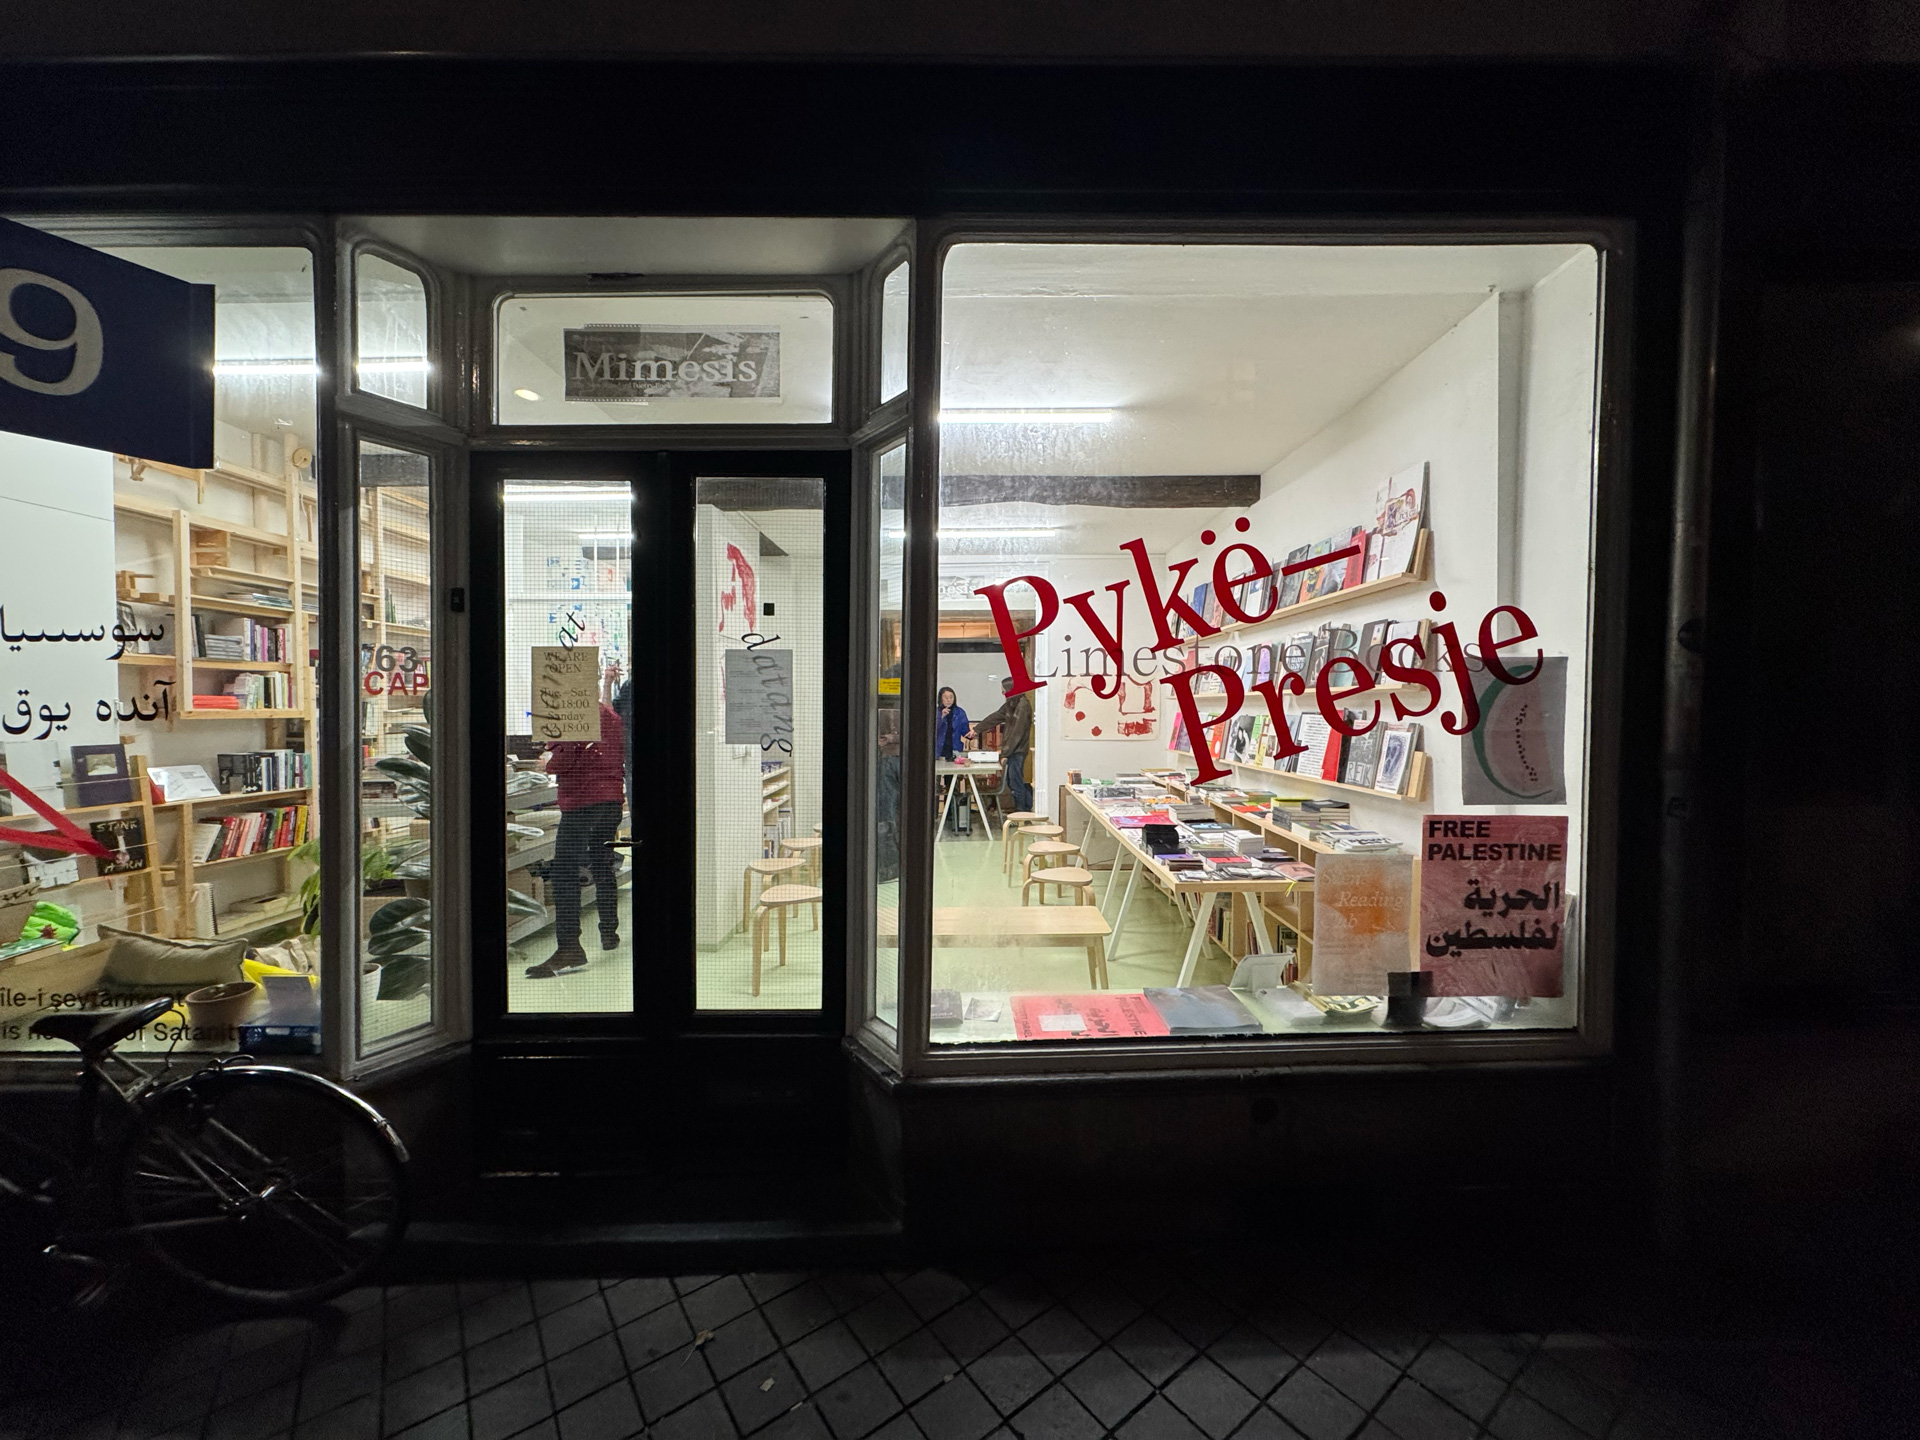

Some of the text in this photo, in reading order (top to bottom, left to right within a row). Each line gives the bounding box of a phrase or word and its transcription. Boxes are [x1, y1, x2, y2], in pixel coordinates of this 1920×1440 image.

[0, 267, 104, 396] 9
[571, 351, 757, 383] Mimesis
[550, 662, 582, 673] OPEN
[563, 651, 588, 662] ARE
[1030, 628, 1486, 677] Limestone Books
[364, 671, 429, 696] CAP
[741, 632, 794, 757] datang
[1160, 591, 1544, 785] Presje
[1428, 820, 1491, 839] FREE
[1427, 843, 1562, 861] PALESTINE
[1335, 890, 1404, 911] Reading
[1463, 878, 1561, 919] الحرية
[1425, 918, 1560, 958] لفلسطين
